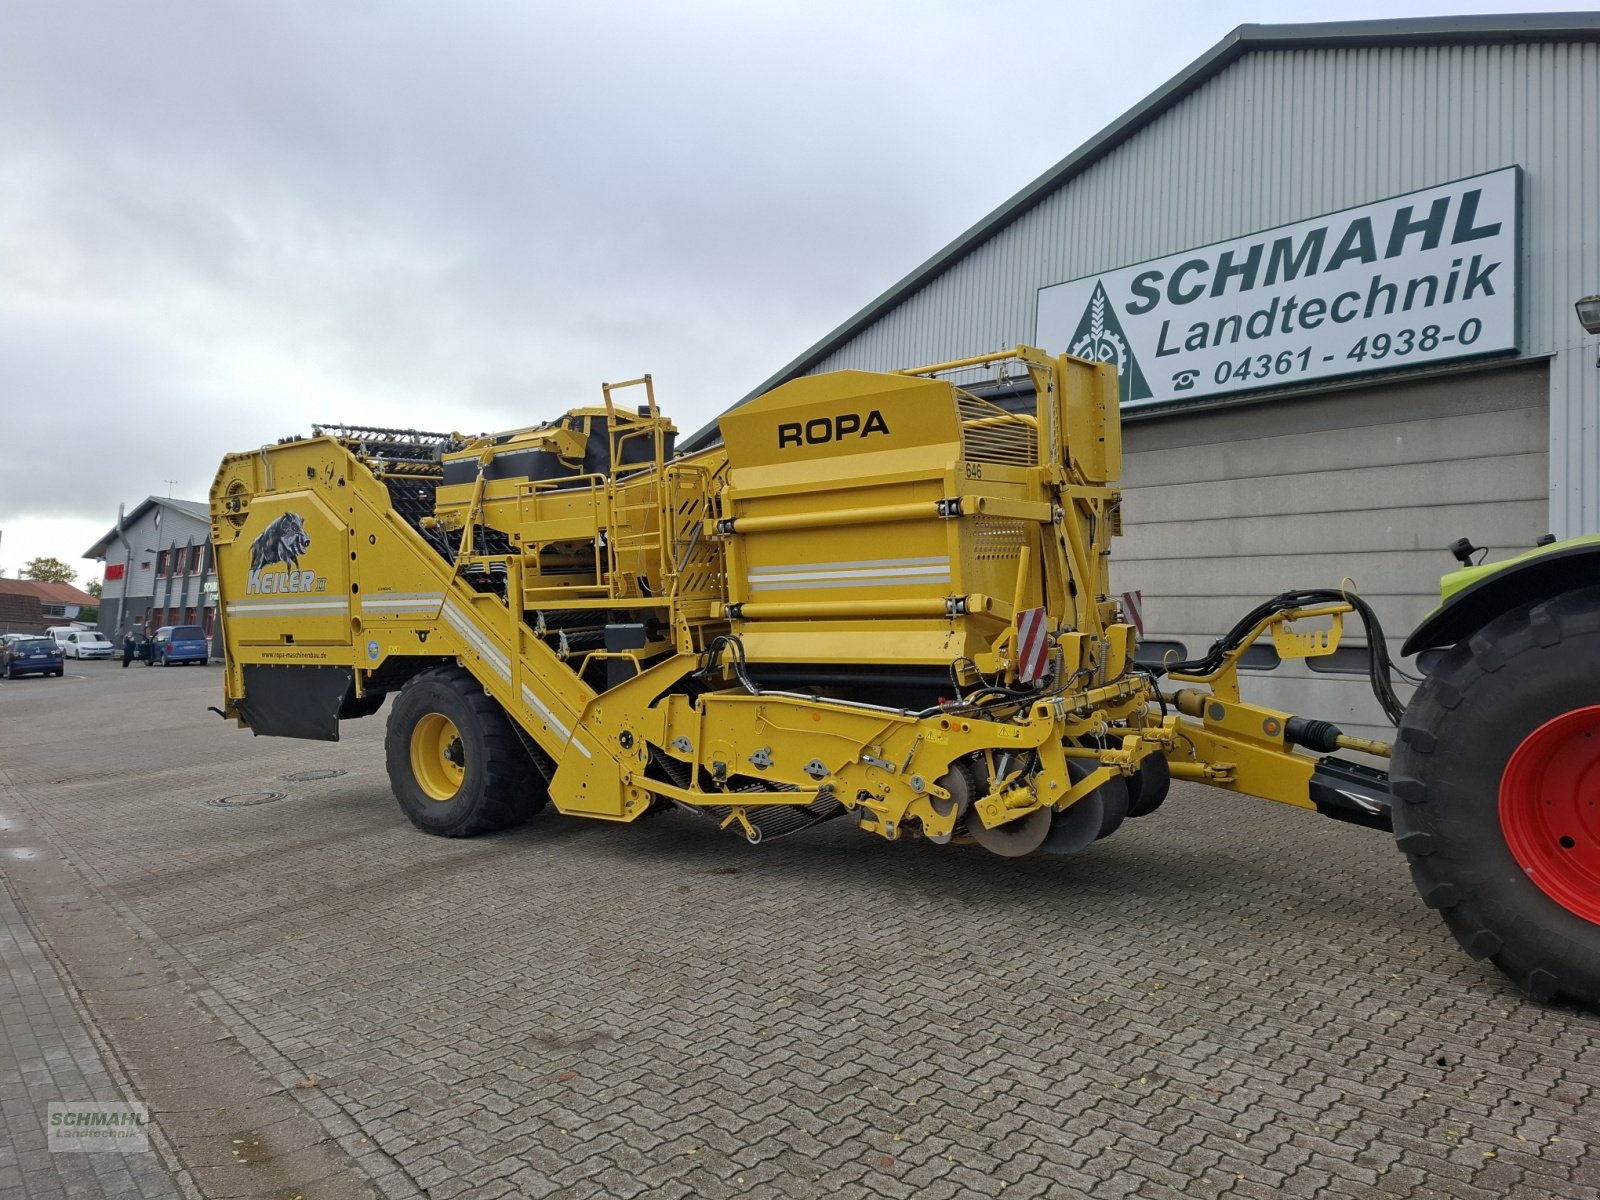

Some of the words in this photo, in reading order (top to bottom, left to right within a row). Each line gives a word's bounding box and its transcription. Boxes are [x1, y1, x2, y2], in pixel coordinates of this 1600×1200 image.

[1125, 189, 1503, 316] SCHMAHL
[1155, 254, 1503, 358] Landtechnik
[1214, 346, 1313, 385] 04361
[1346, 318, 1483, 361] 4938-0
[778, 410, 890, 448] ROPA
[966, 462, 981, 478] 646
[246, 569, 315, 595] KEILER
[262, 651, 327, 660] www.ropa-maschinenbau.de
